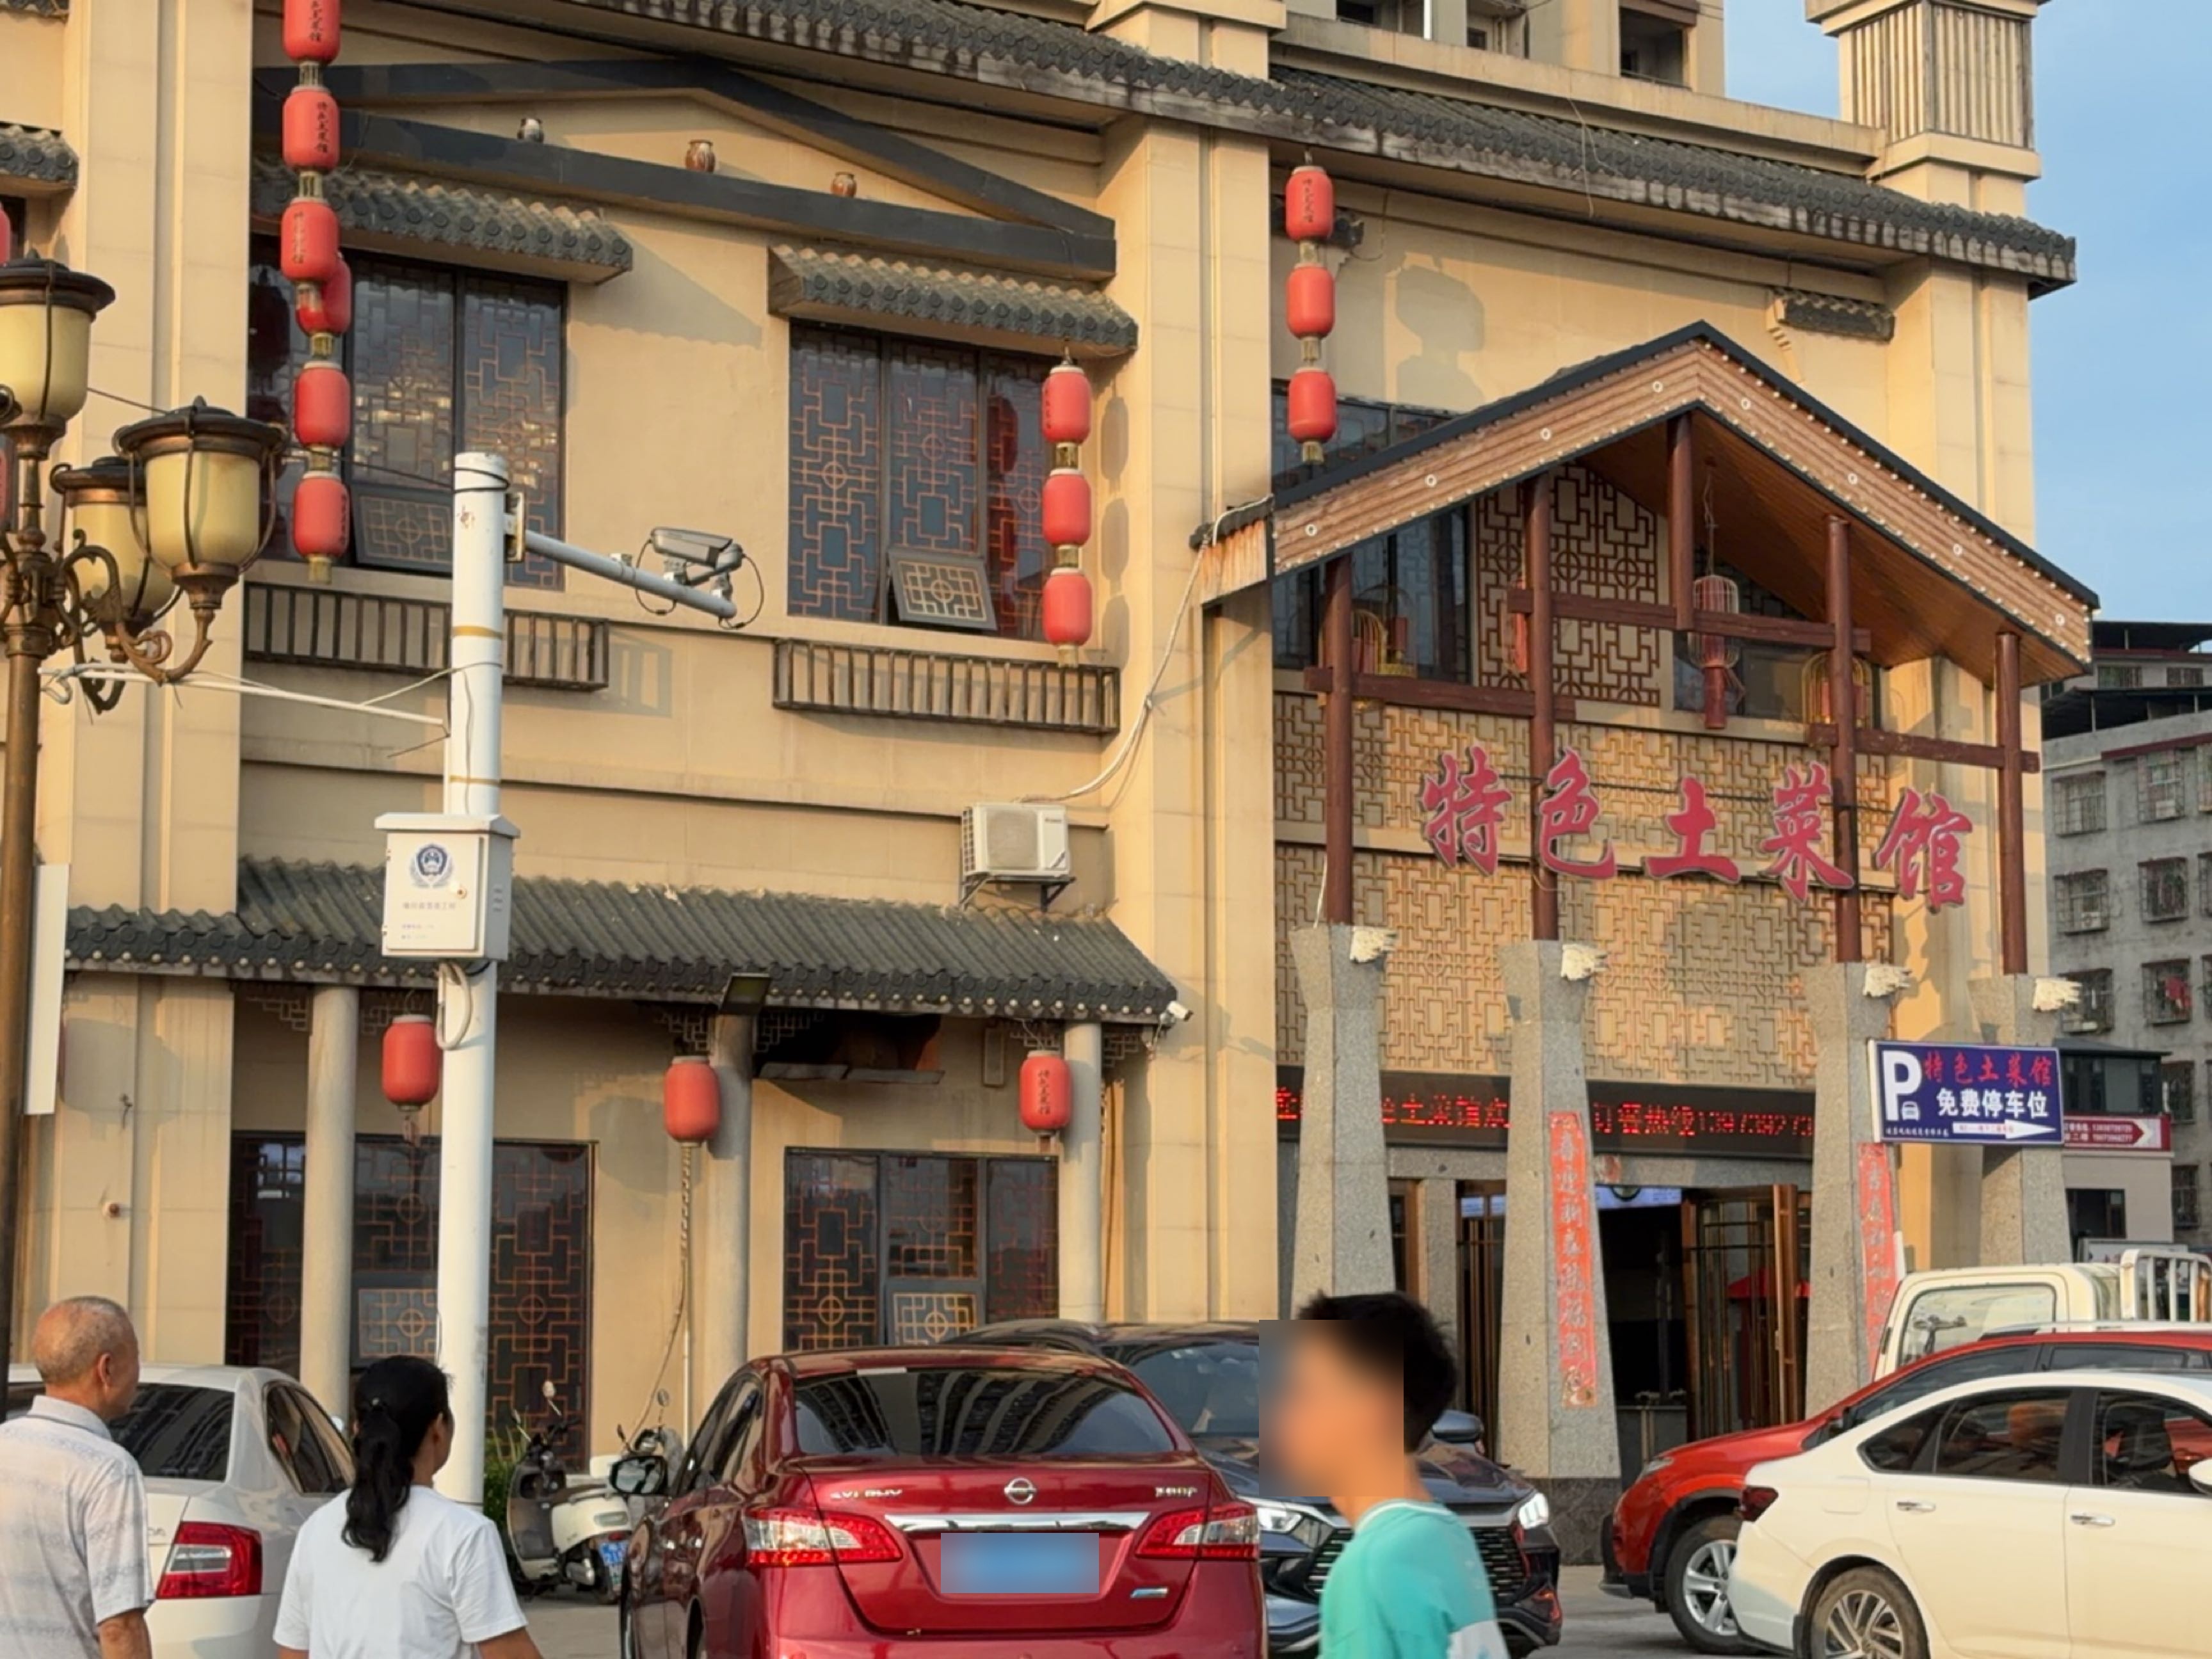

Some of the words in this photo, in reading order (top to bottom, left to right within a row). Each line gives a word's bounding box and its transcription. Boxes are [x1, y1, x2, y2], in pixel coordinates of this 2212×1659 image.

[1422, 744, 1974, 913] 特色土菜馆
[1882, 1050, 1922, 1121] P
[1924, 1050, 2052, 1088] 特色土菜馆
[1936, 1087, 2049, 1119] 免费停车位
